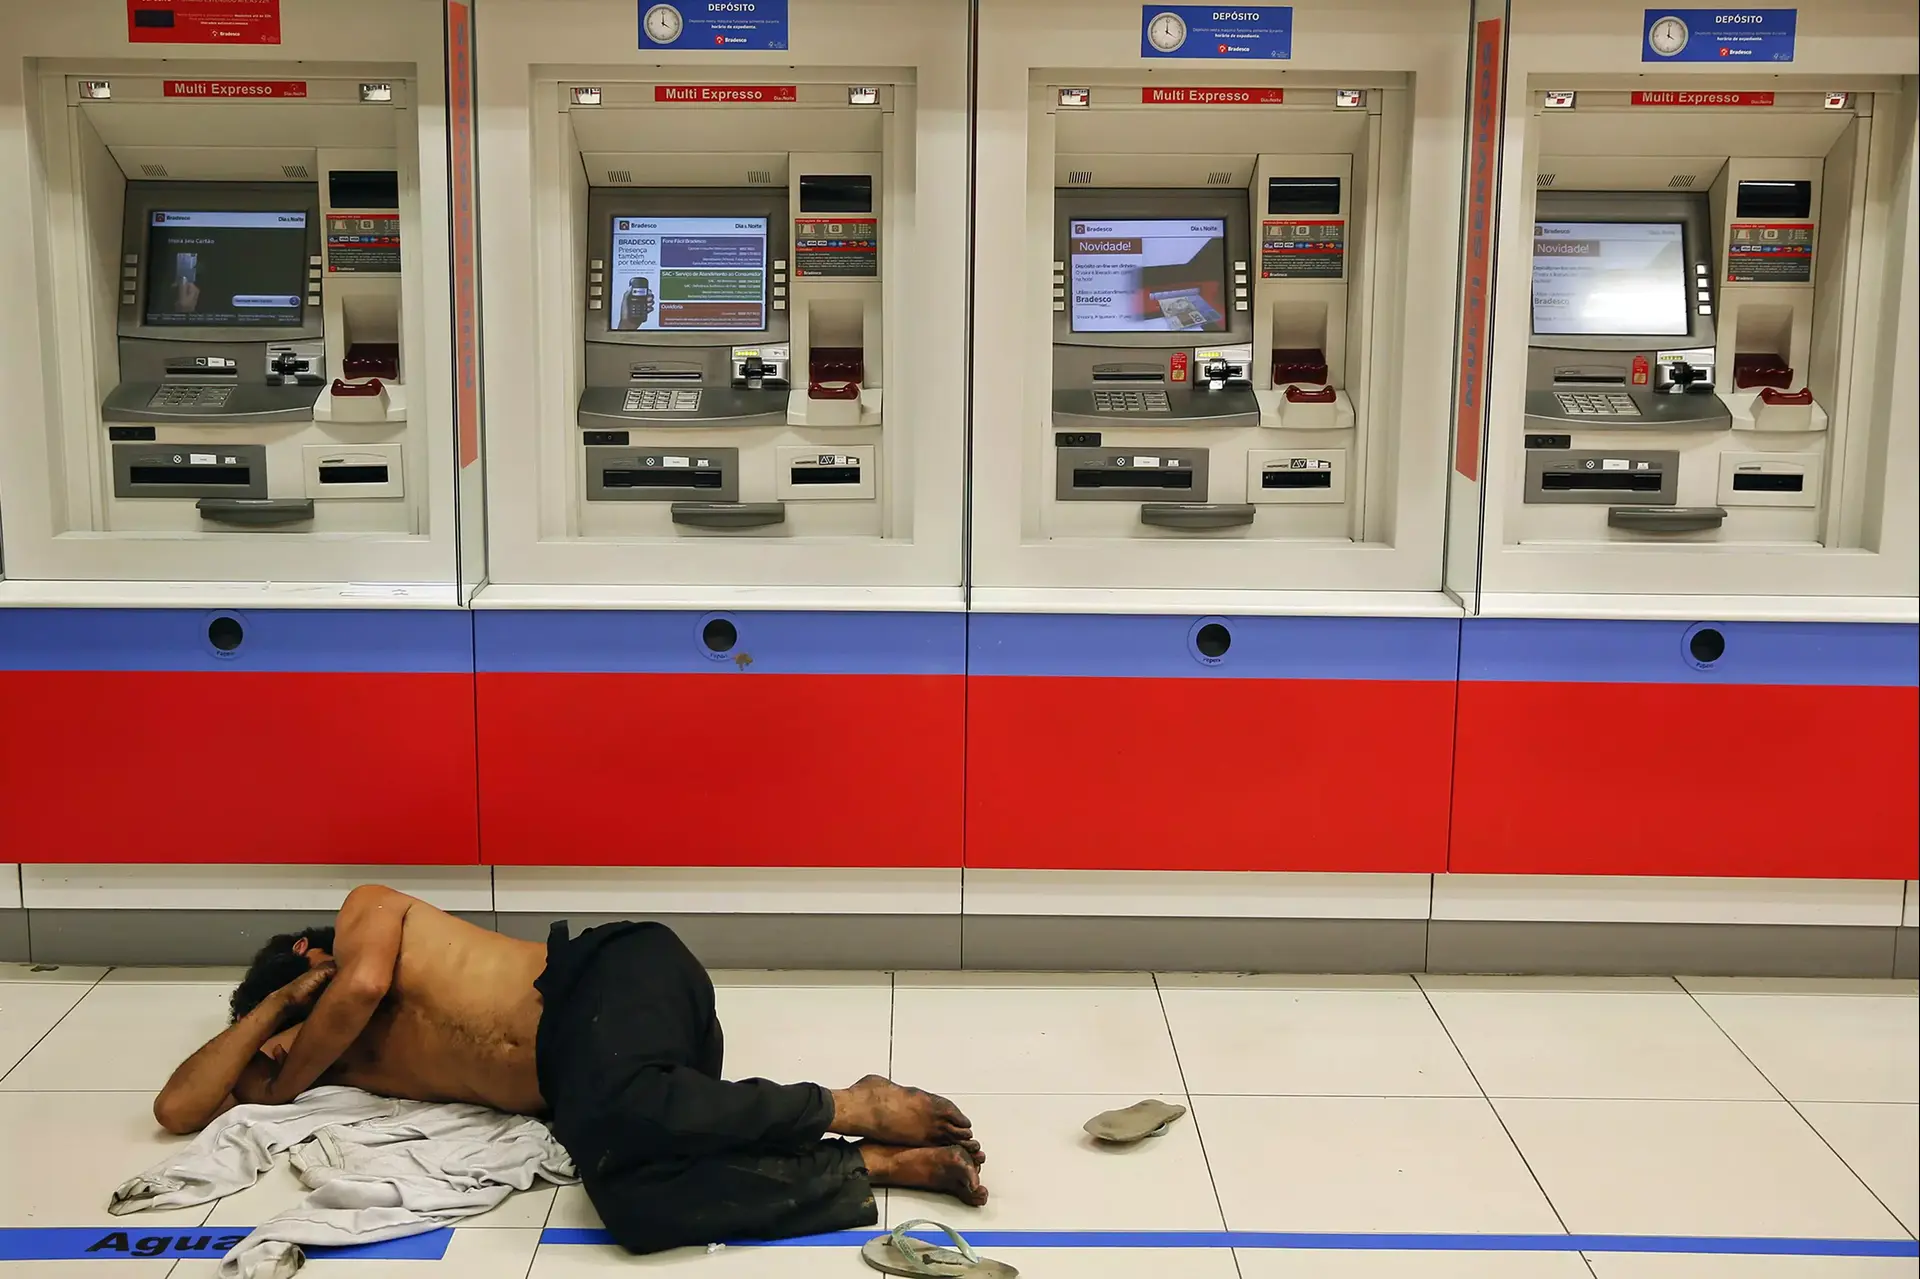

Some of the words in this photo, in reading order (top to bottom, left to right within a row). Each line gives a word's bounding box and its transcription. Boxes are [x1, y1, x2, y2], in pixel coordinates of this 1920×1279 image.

[708, 2, 755, 11] DEPÓSITO
[1213, 11, 1259, 20] DEPÓSITO
[1715, 14, 1763, 23] DEPÓSITO
[174, 83, 206, 94] Multi
[212, 84, 272, 96] Expresso
[666, 88, 697, 99] Multi
[702, 89, 762, 101] Expresso
[1153, 90, 1184, 100] Multi
[1189, 90, 1250, 102] Expresso
[1642, 92, 1674, 102] Multi
[1678, 92, 1739, 104] Expresso
[1465, 276, 1481, 408] MULTI
[1474, 41, 1492, 260] SERVIÇOS
[1079, 242, 1131, 251] Novidade!
[1537, 244, 1589, 253] Novidade!
